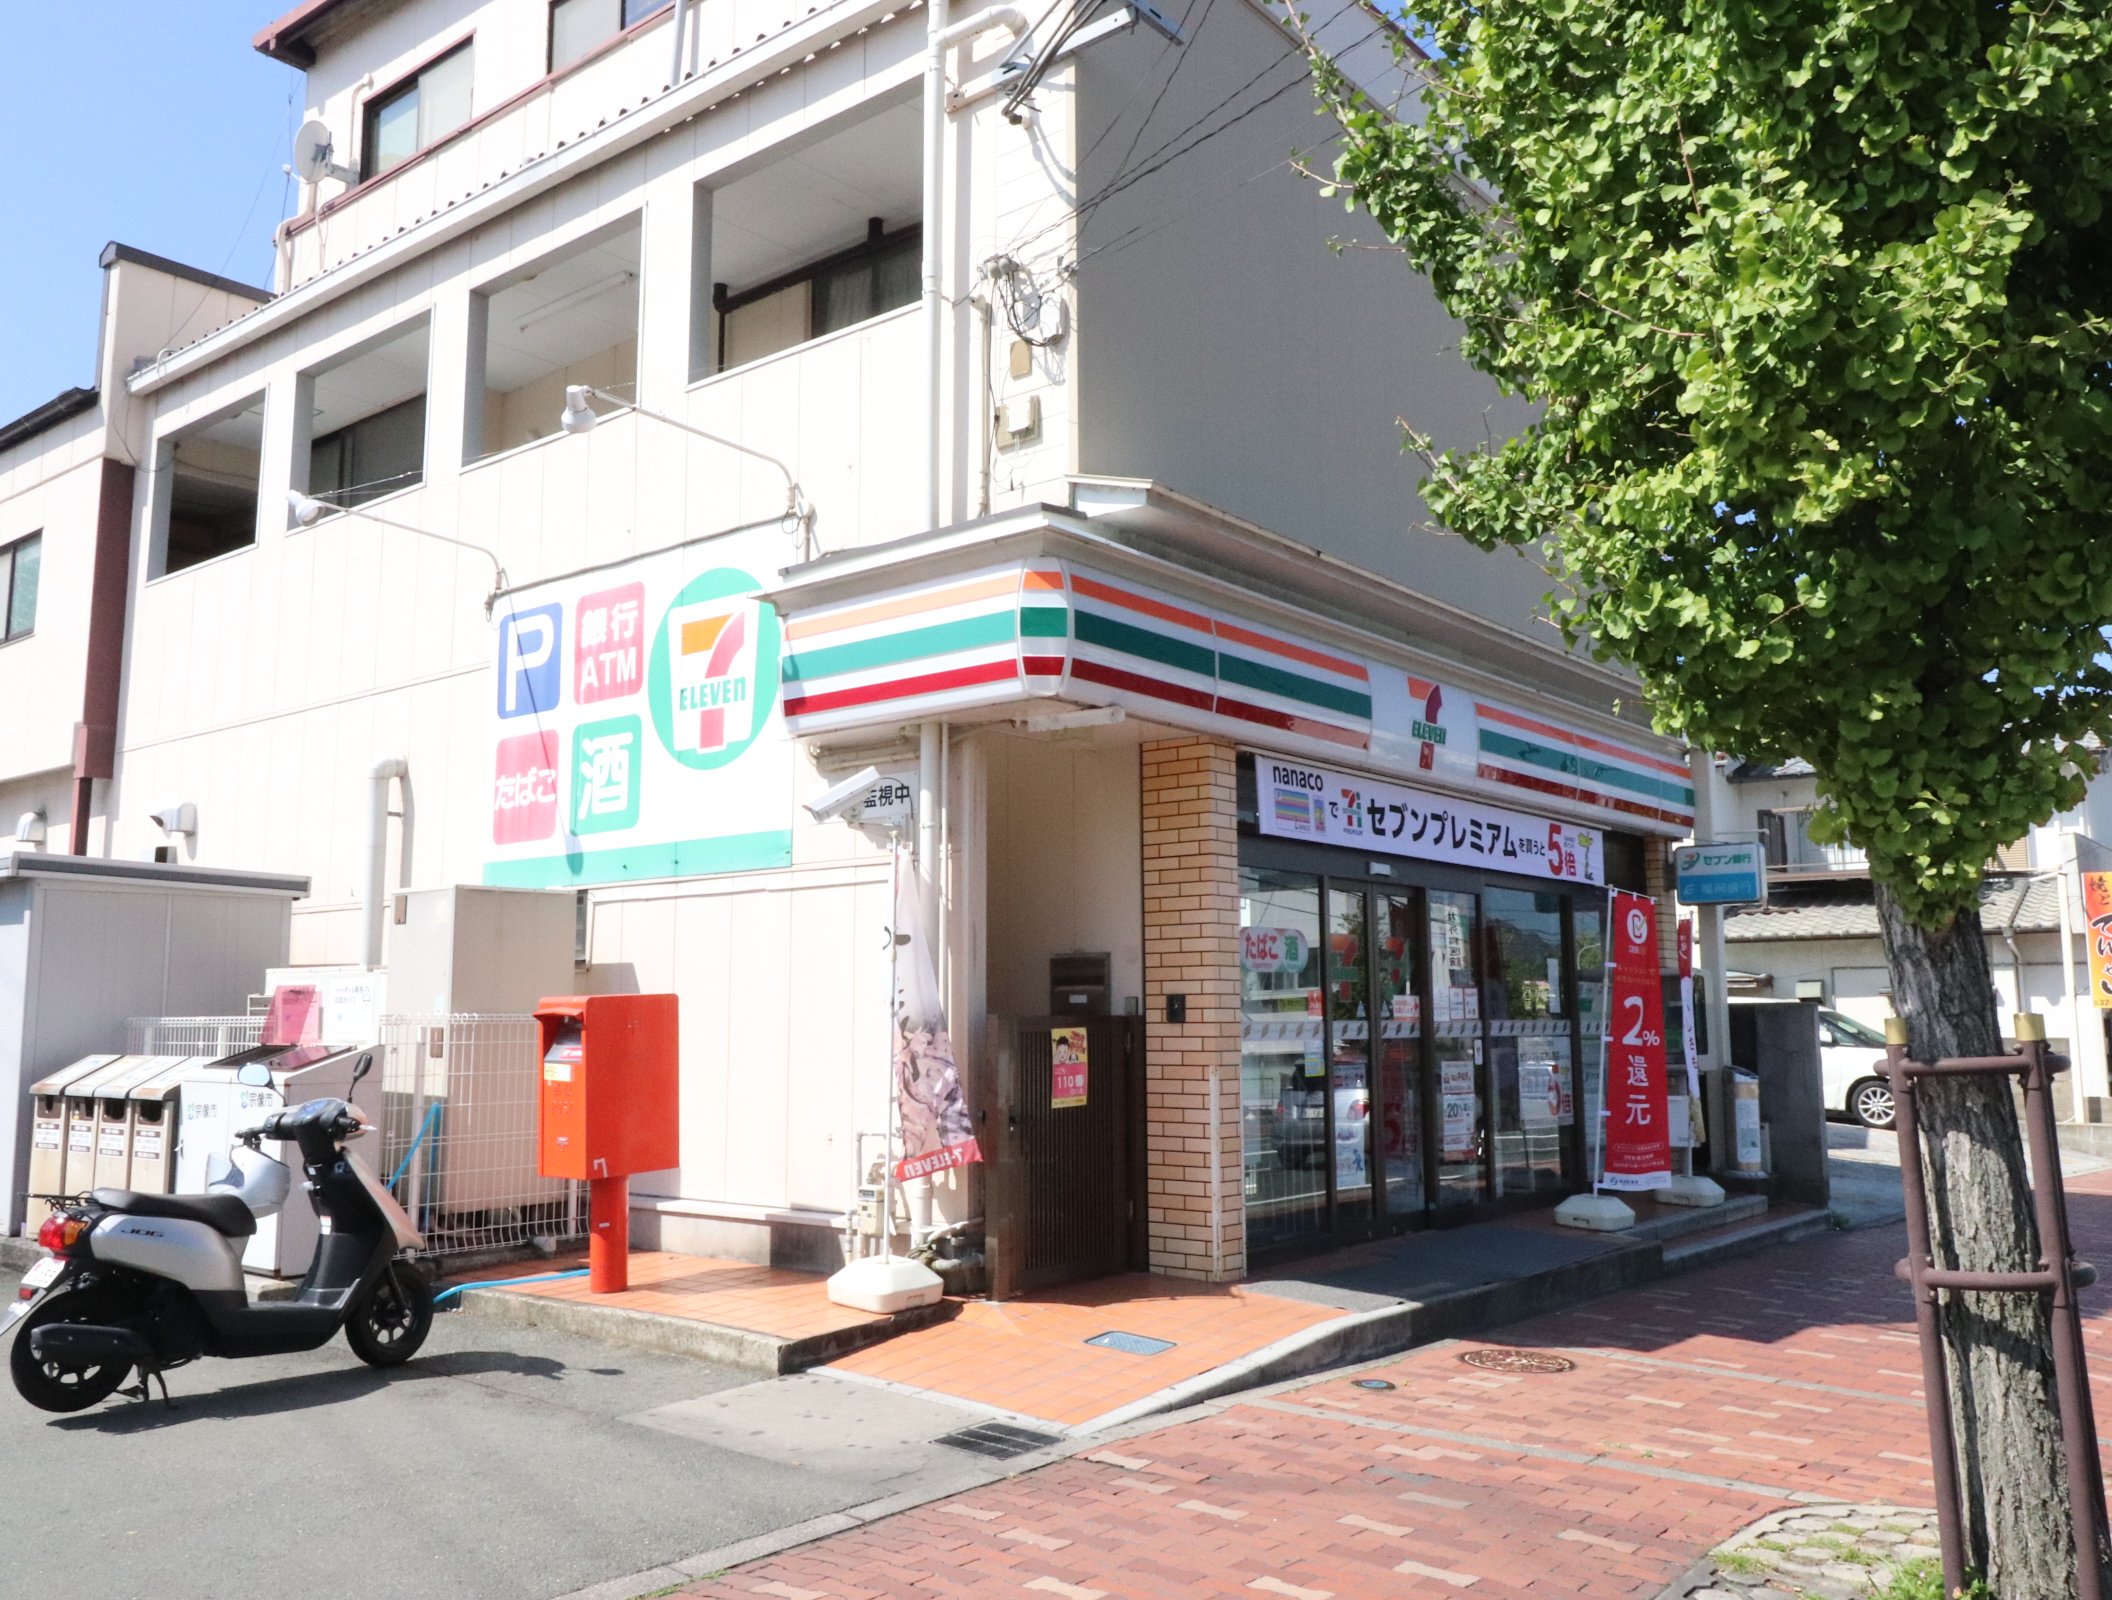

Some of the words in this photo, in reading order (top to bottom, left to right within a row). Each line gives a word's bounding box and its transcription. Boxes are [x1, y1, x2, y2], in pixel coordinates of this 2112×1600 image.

[581, 600, 639, 648] 銀行
[505, 613, 554, 712] P
[580, 646, 637, 691] ATM
[495, 765, 557, 810] たばこ
[578, 731, 634, 820] 酒
[1272, 765, 1324, 792] nanaco
[1703, 853, 1752, 866] セブン銀行
[1245, 932, 1279, 960] たばこ
[1625, 1054, 1651, 1125] 還元
[121, 1228, 165, 1238] JOG
